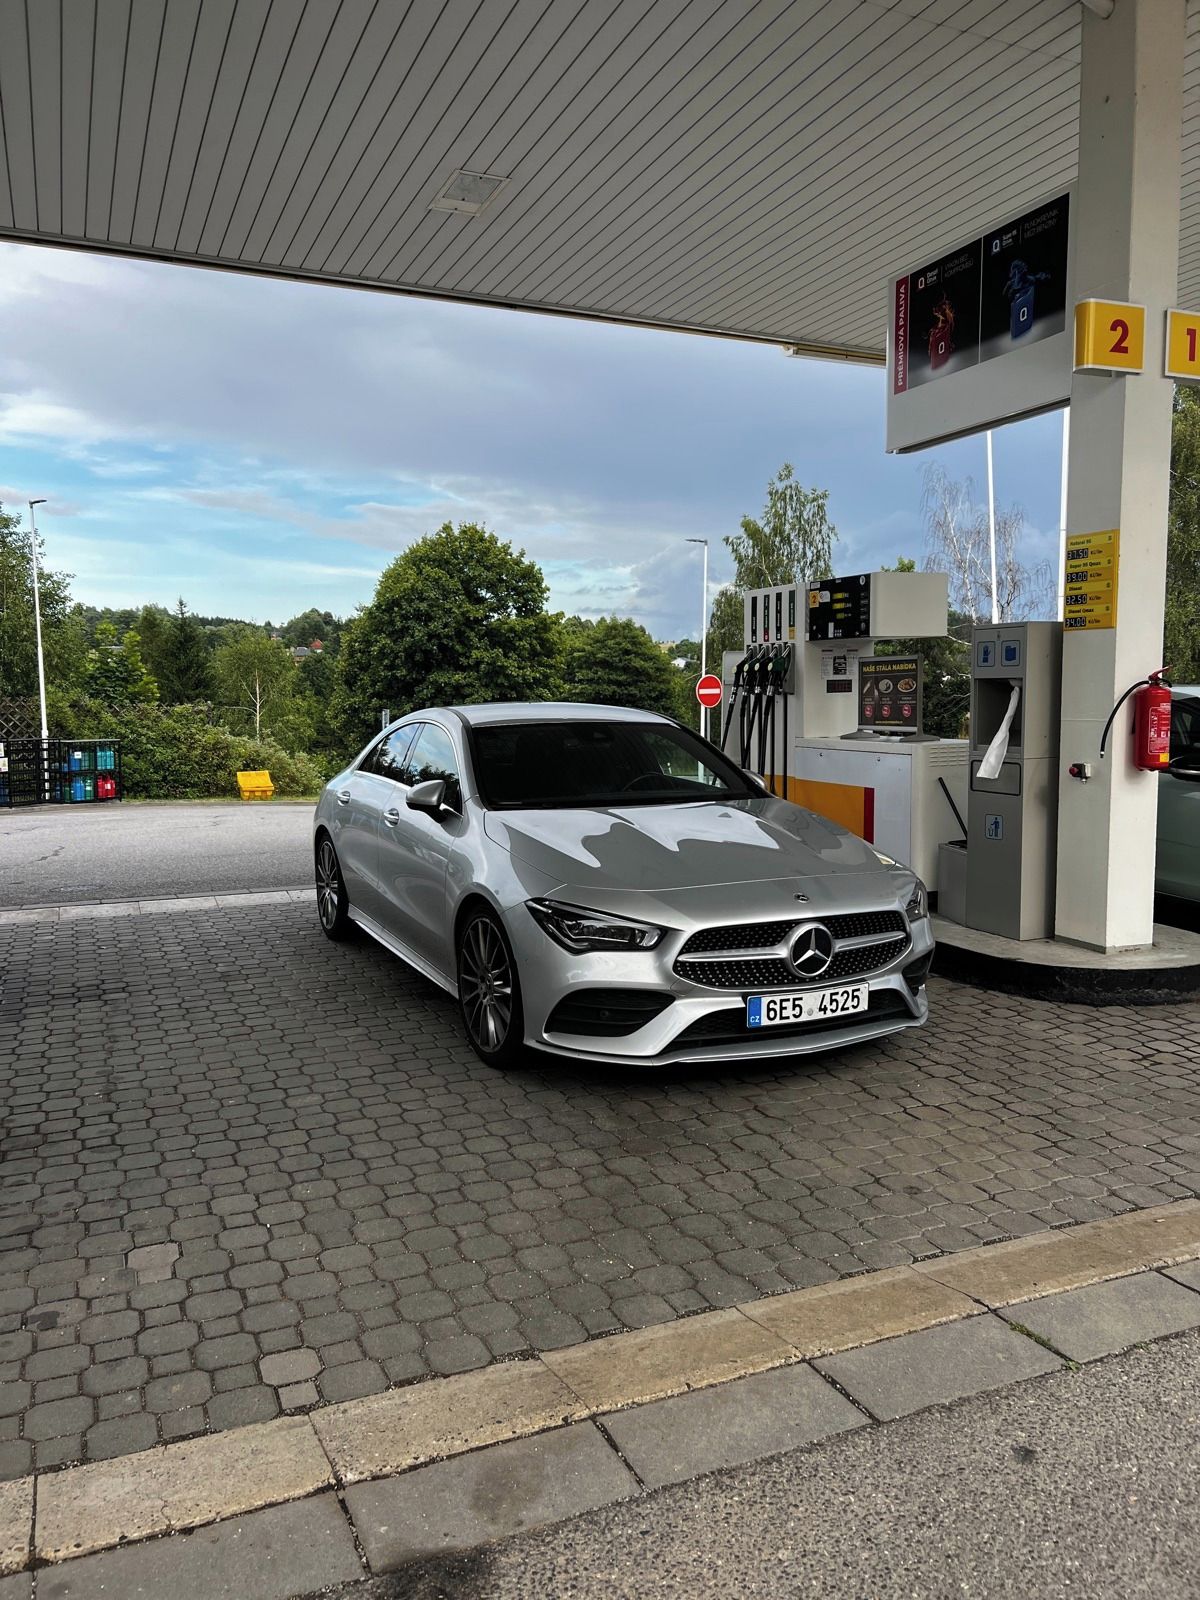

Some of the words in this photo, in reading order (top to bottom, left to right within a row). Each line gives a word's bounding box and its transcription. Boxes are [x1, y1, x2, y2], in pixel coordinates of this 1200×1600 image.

[1109, 319, 1129, 354] 2
[1186, 328, 1197, 362] 1
[1068, 548, 1088, 560] 37.50
[1068, 572, 1088, 582] 39.00
[1066, 594, 1087, 605] 32.50
[1065, 617, 1086, 628] 34.00
[766, 996, 803, 1021] 6E5
[818, 988, 860, 1015] 4525
